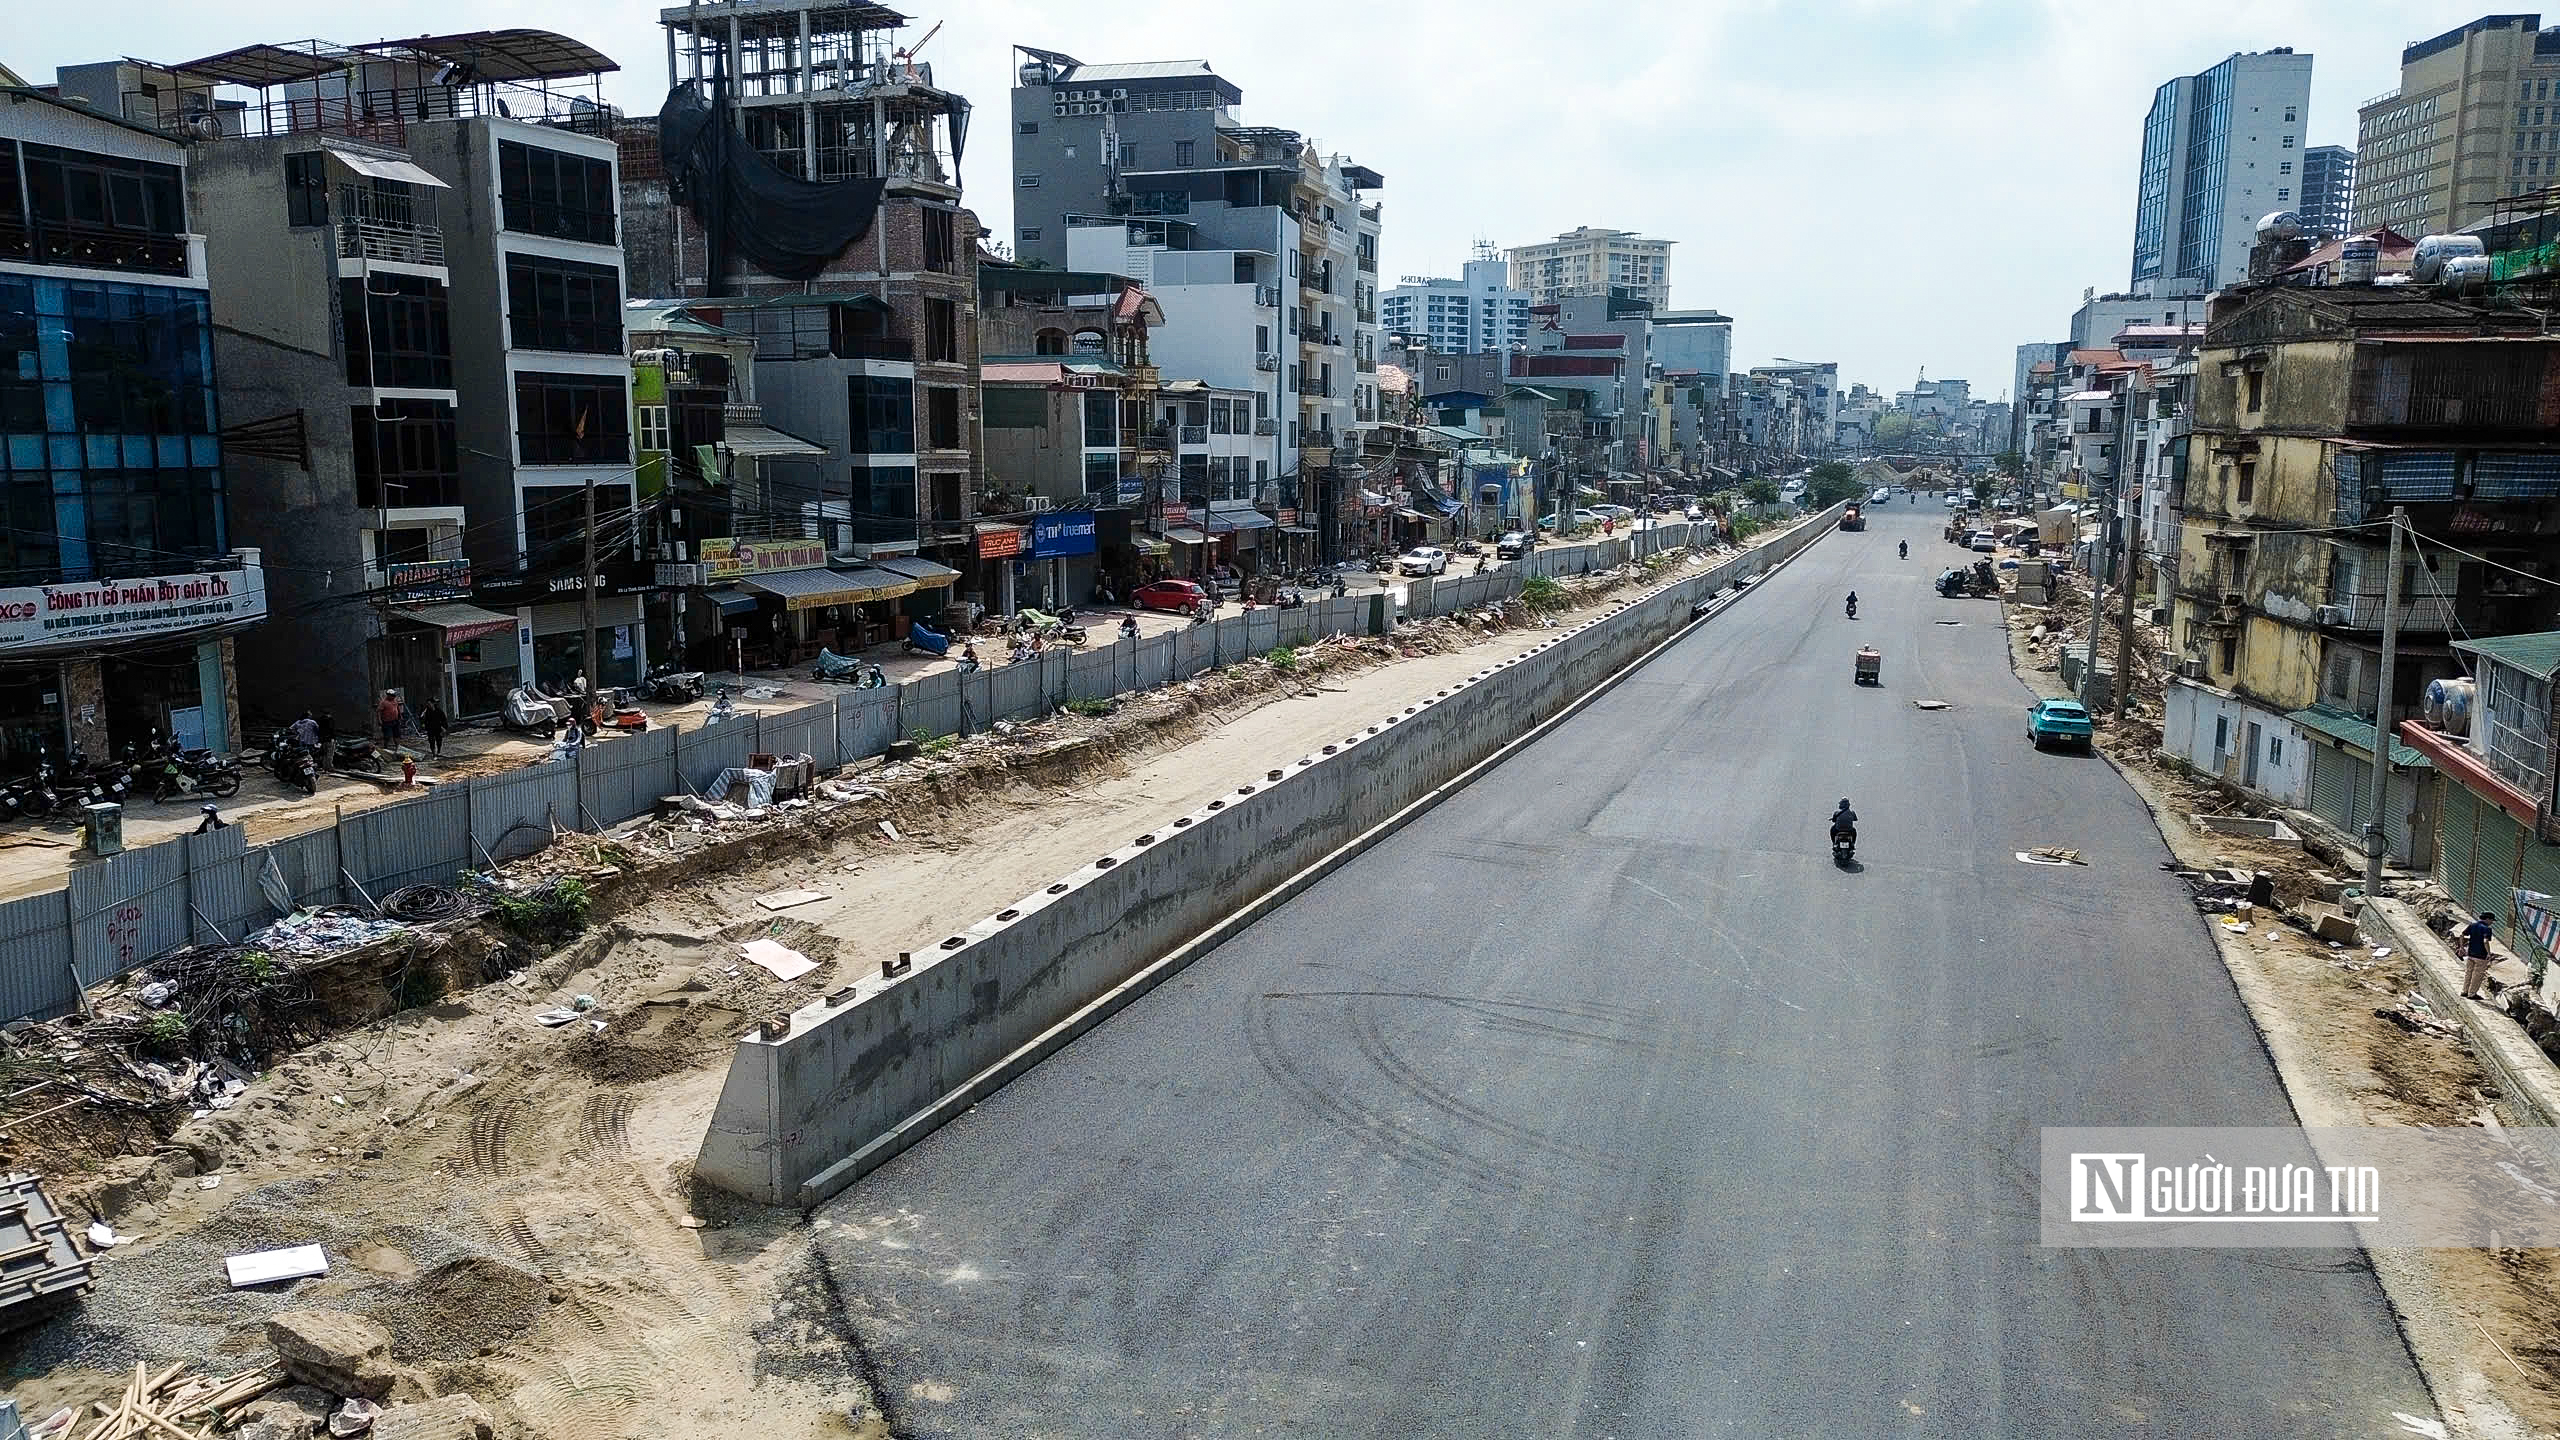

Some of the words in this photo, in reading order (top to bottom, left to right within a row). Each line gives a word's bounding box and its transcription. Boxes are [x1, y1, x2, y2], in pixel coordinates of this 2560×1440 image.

[1063, 520, 1096, 537] truemart
[809, 547, 824, 565] ANH
[549, 574, 606, 592] SAMSNG
[48, 591, 82, 611] CÔNG
[85, 591, 99, 607] TY
[103, 583, 119, 605] CỔ
[122, 582, 155, 604] PHẦN
[158, 583, 180, 601] BỘT
[184, 580, 208, 601] GIẶT
[211, 580, 229, 596] LIX
